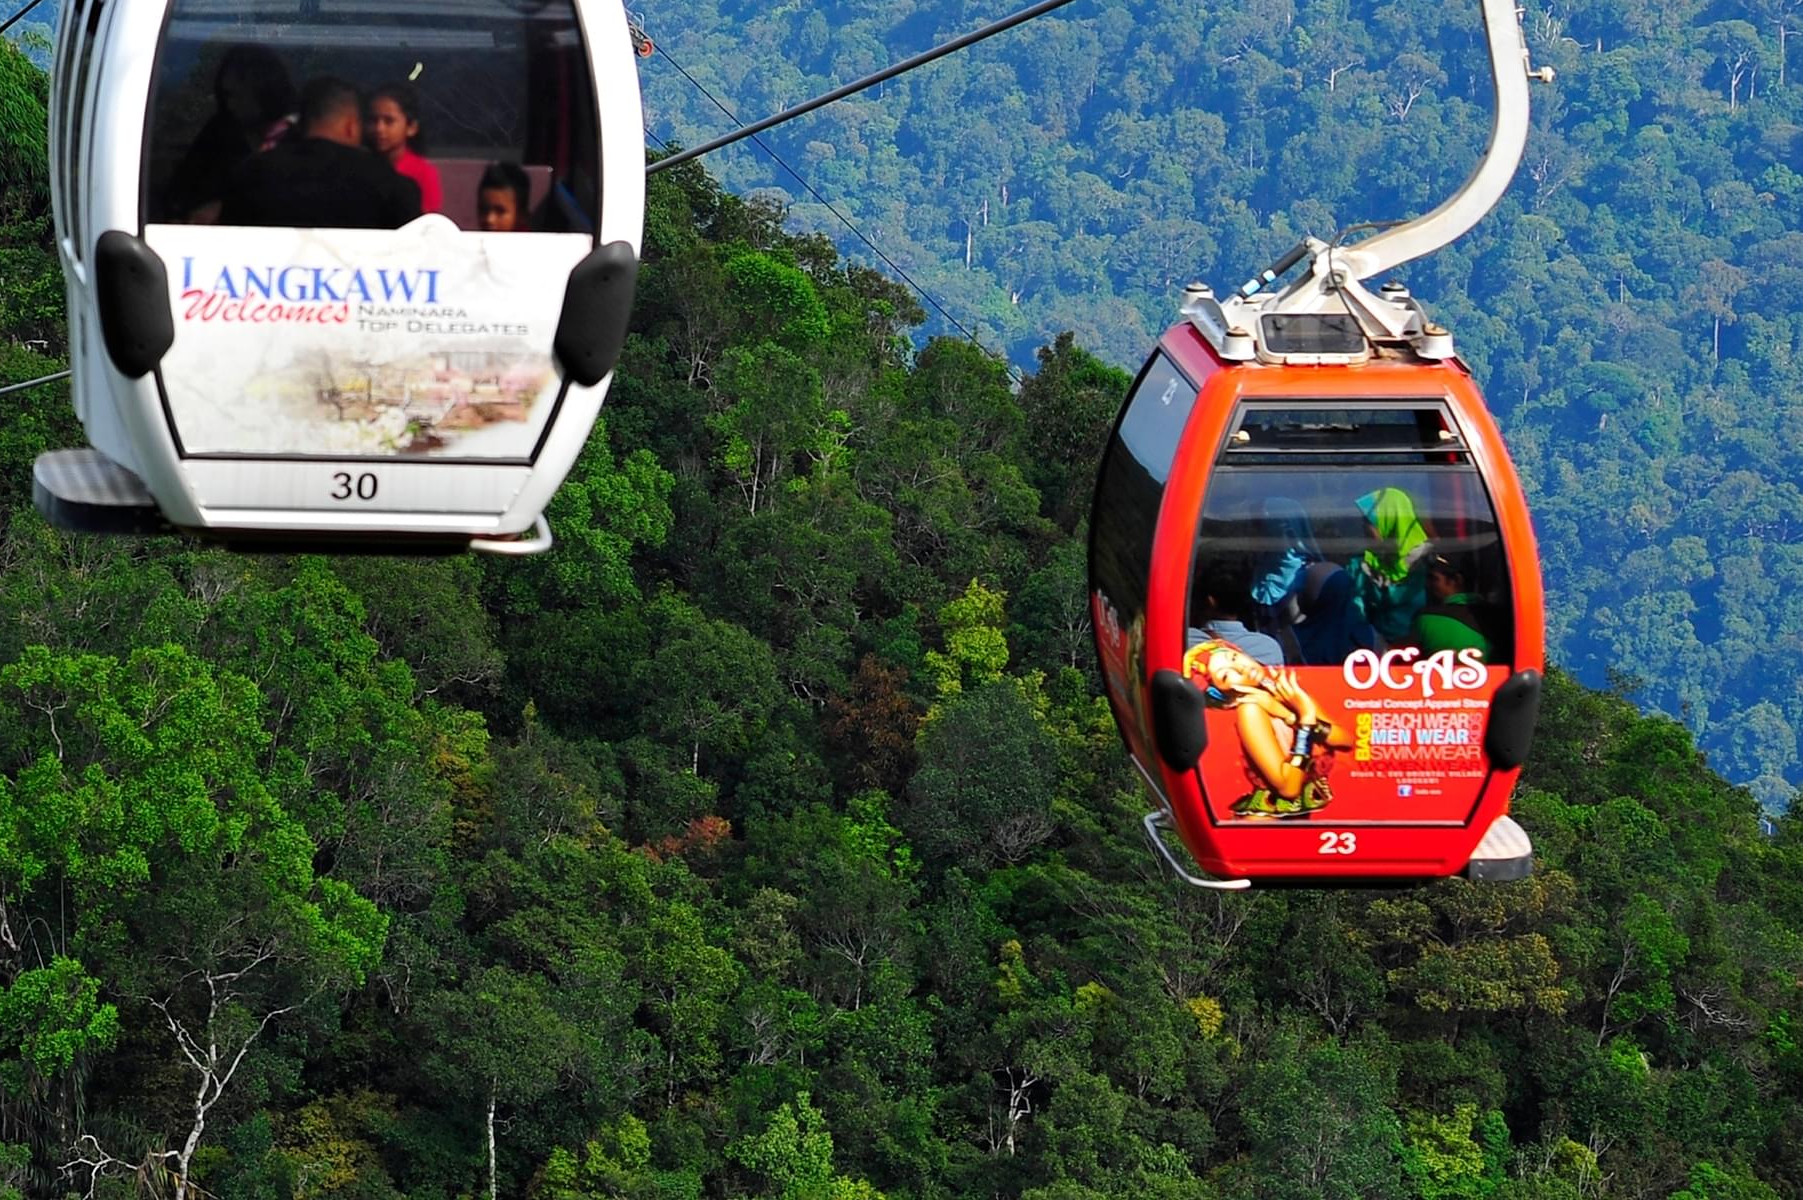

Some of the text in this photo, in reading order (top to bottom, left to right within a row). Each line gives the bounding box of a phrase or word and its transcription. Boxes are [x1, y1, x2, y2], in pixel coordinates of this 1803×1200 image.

[180, 256, 441, 304] LANGKAWI
[180, 289, 350, 324] Welcomes
[356, 319, 529, 336] TOP DELEGATES
[331, 472, 378, 500] 30
[1343, 647, 1489, 697] OCAS
[1344, 699, 1490, 710] Oriental Concept Apparel Store
[1371, 712, 1470, 729] BEACH WEAR
[1355, 712, 1372, 761] BAGS
[1370, 729, 1470, 745] MEN WEAR
[1371, 745, 1481, 761] SWIMWEAR
[1318, 831, 1357, 855] 23
